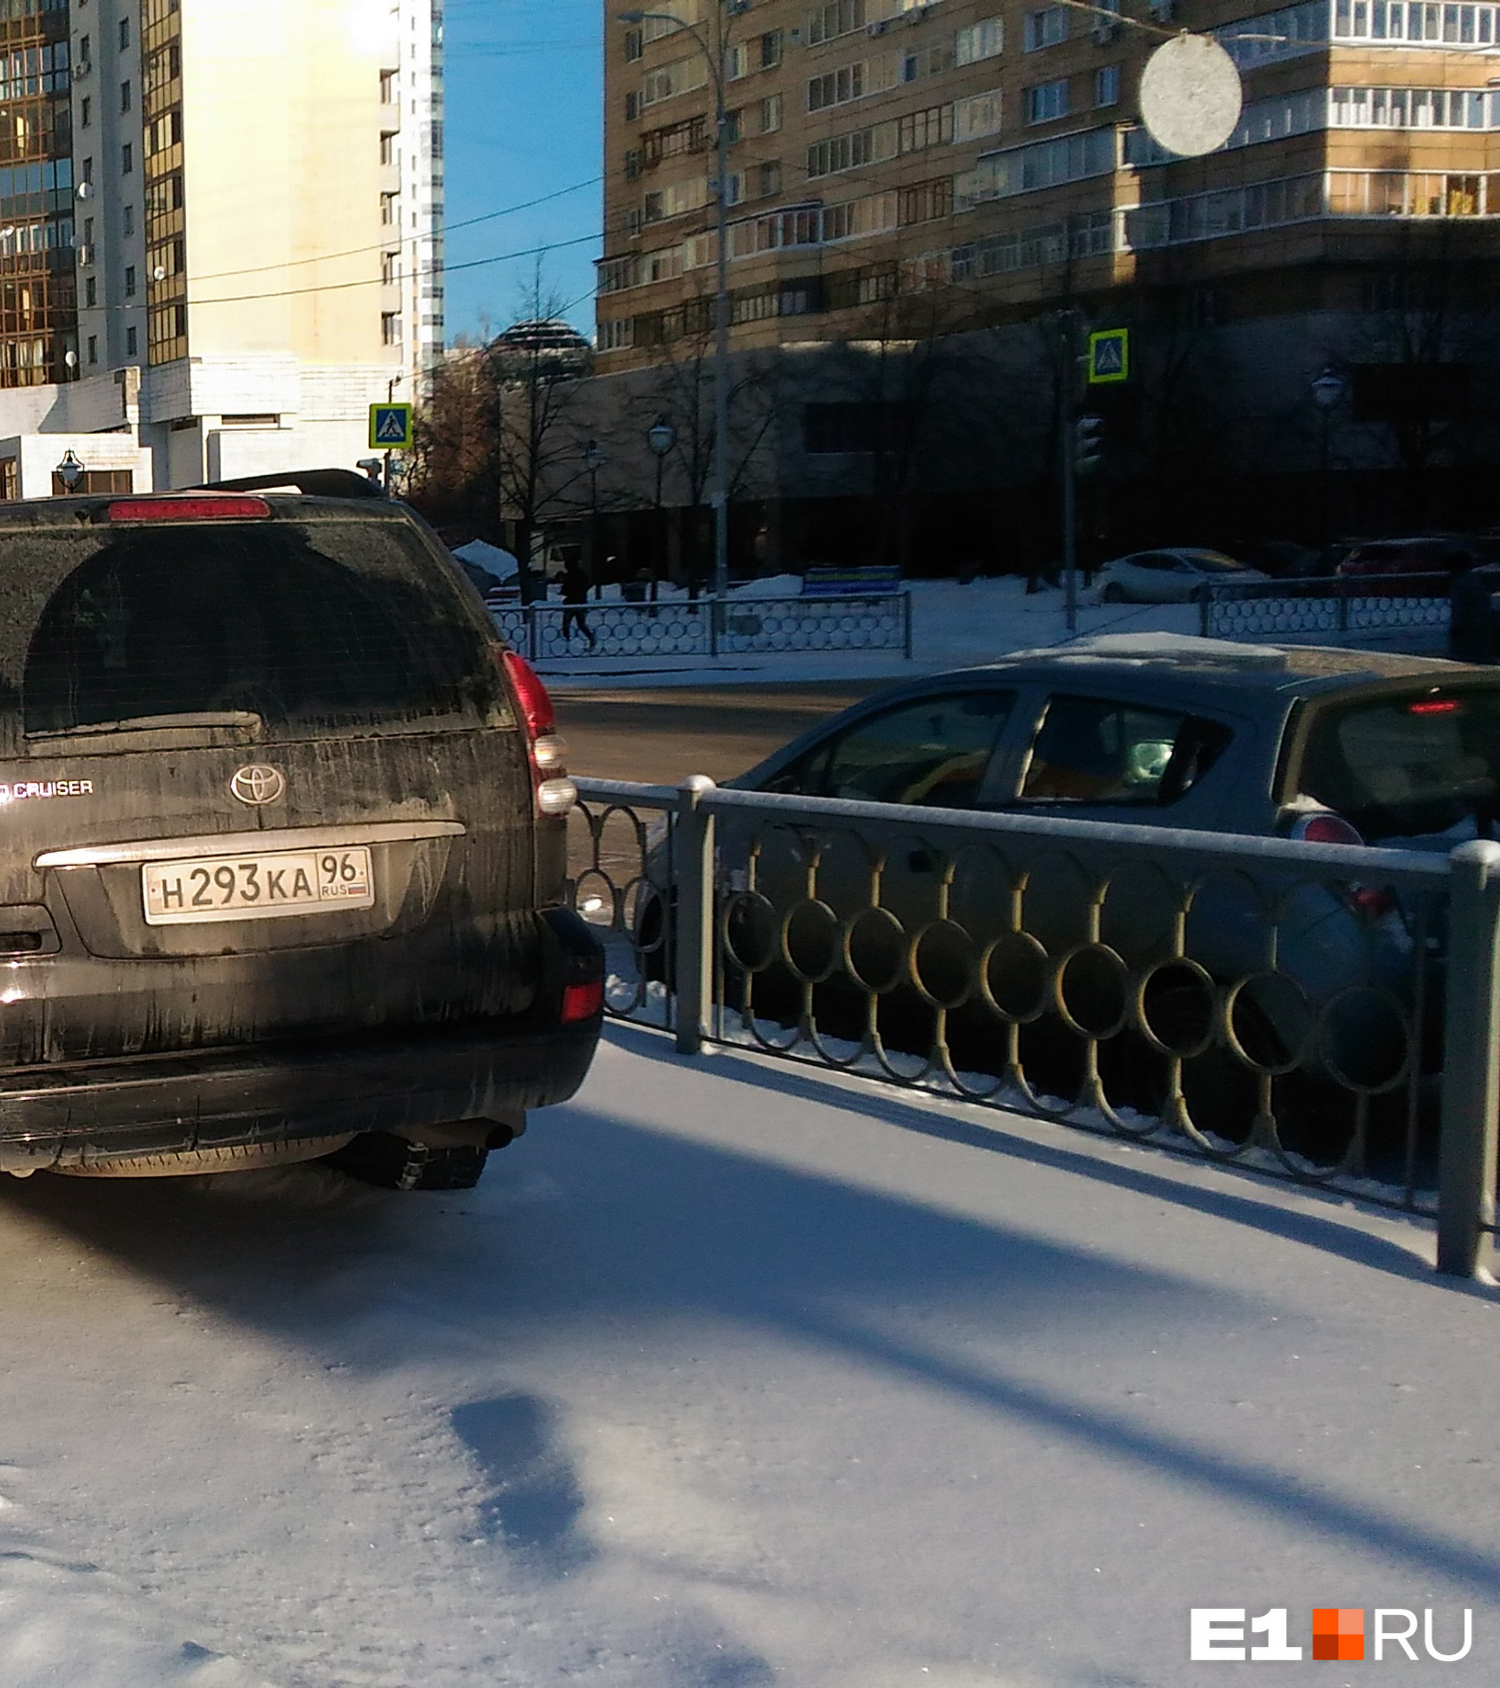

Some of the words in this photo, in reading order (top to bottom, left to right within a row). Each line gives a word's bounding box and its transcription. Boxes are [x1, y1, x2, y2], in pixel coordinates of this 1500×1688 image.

[13, 780, 94, 799] CRUISER
[321, 853, 356, 884] 96
[321, 884, 347, 897] RUS
